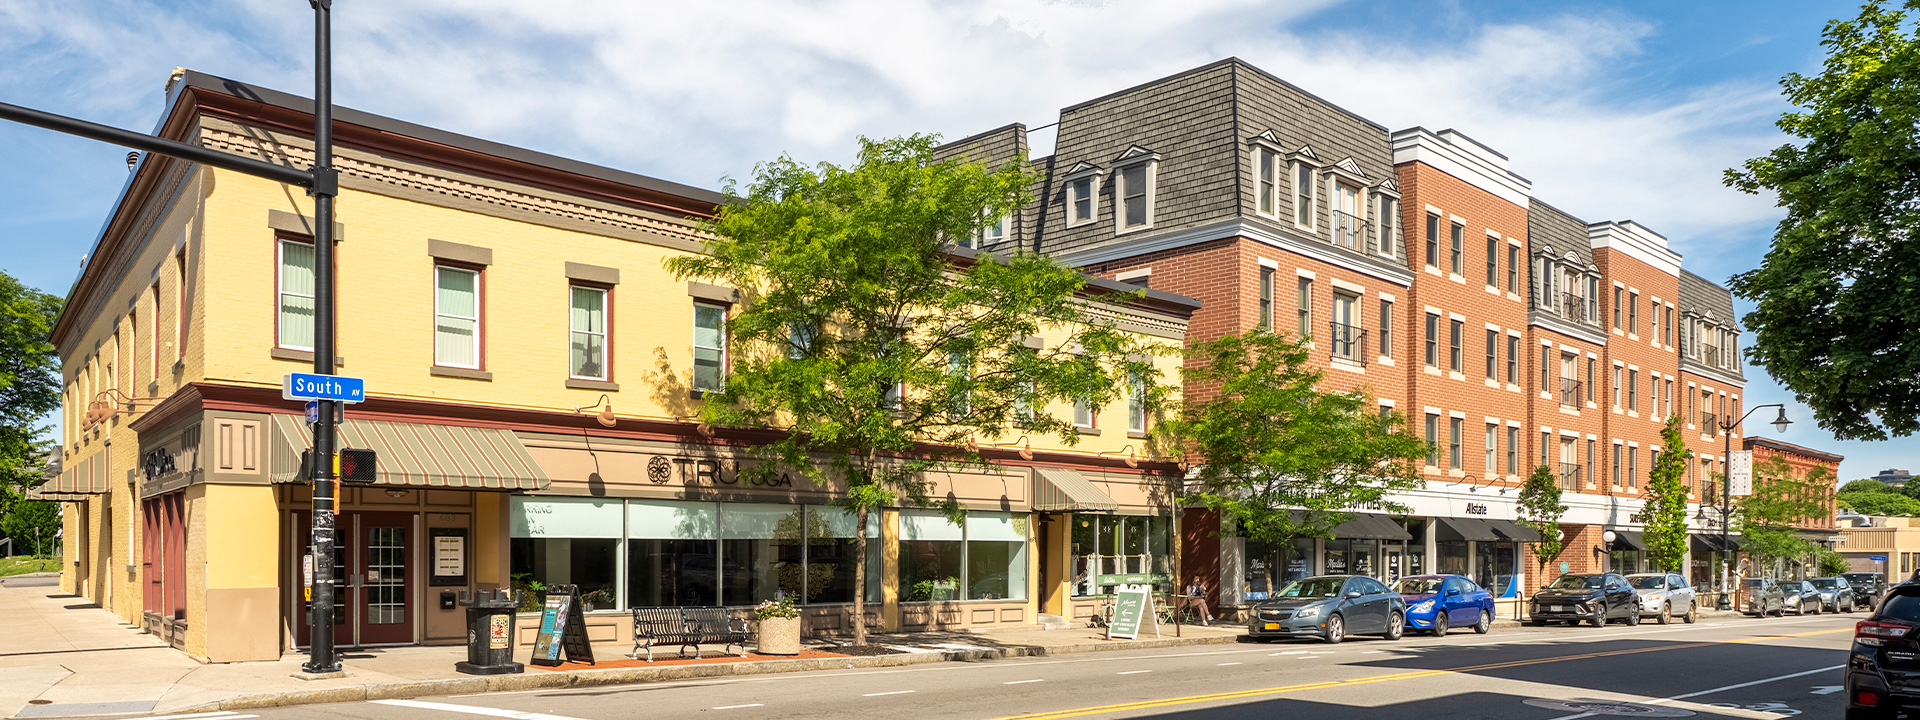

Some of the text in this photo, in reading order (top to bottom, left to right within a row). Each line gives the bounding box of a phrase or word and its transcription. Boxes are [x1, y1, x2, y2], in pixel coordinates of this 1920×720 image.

[296, 378, 360, 397] South AV
[671, 458, 792, 488] TRU OGA
[1466, 502, 1487, 515] Allstate
